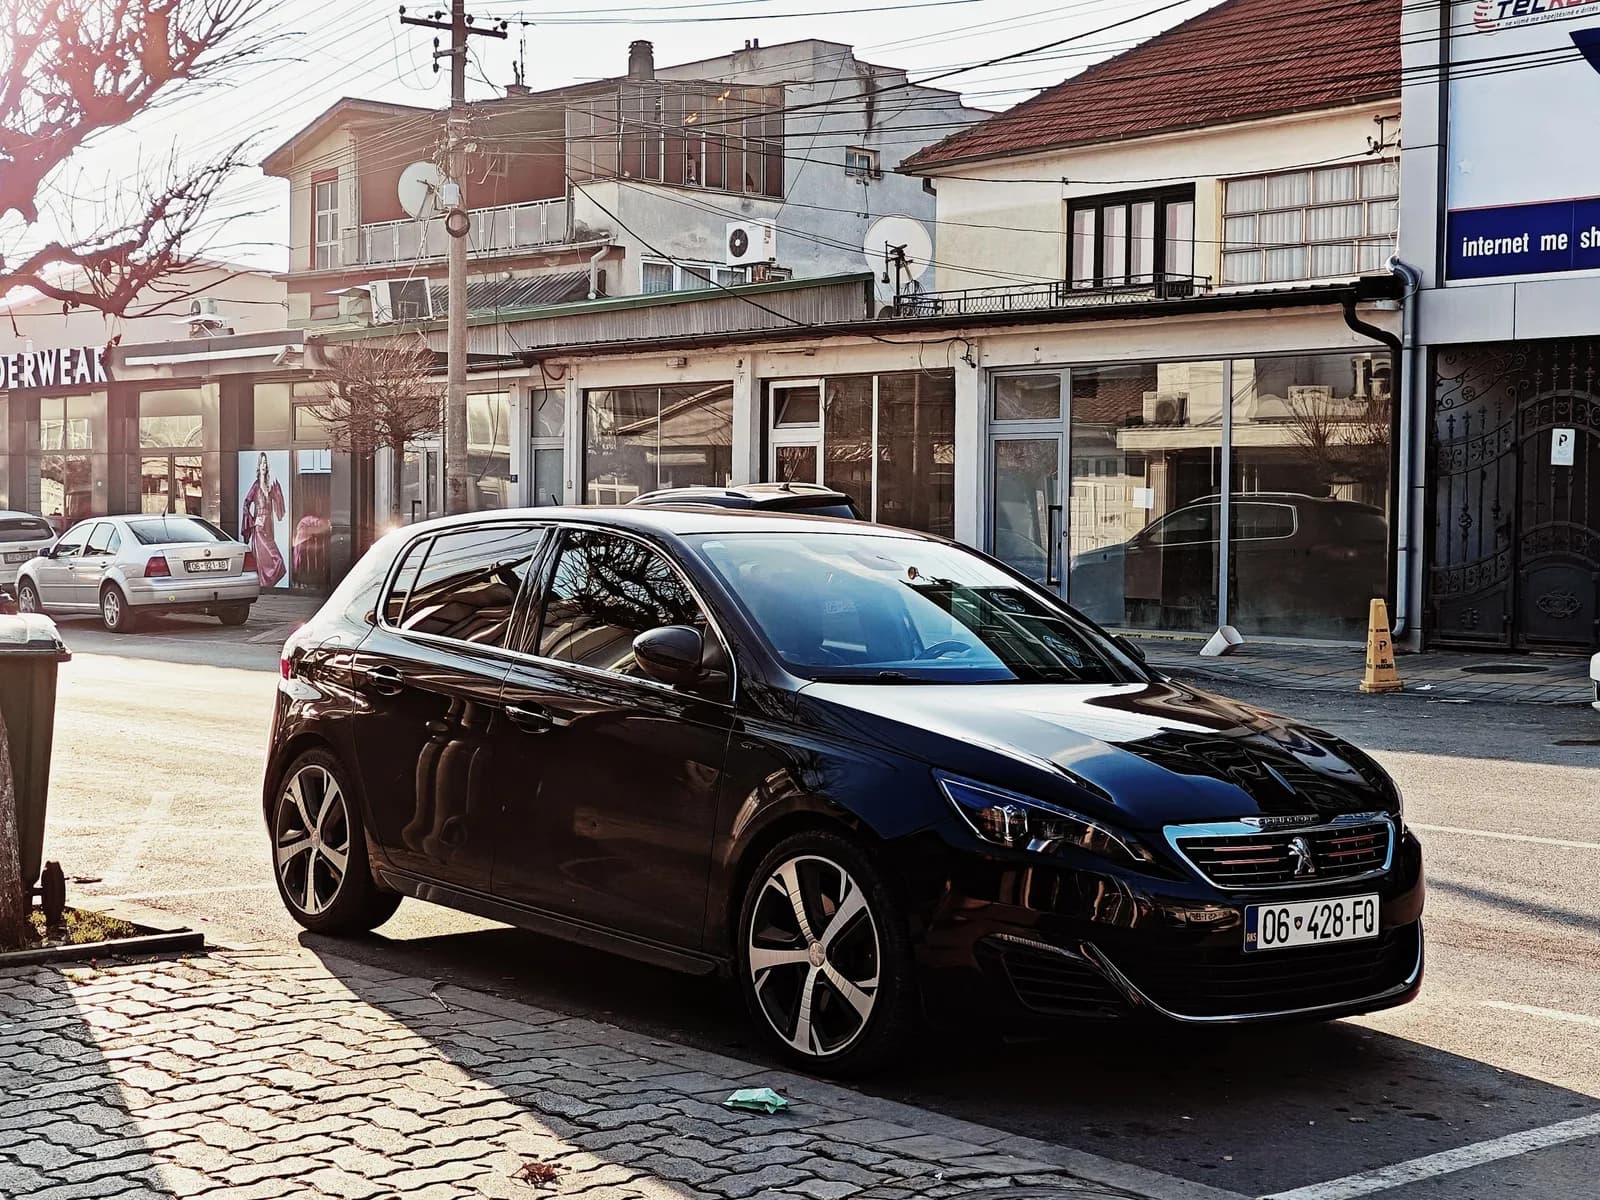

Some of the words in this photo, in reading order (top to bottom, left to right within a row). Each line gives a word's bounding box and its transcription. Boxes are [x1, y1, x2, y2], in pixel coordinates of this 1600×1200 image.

[1462, 232, 1530, 257] internet
[1540, 233, 1568, 252] me
[1580, 226, 1600, 249] sh
[1559, 434, 1568, 447] P
[1246, 932, 1257, 943] RKS
[1262, 908, 1290, 945] 06
